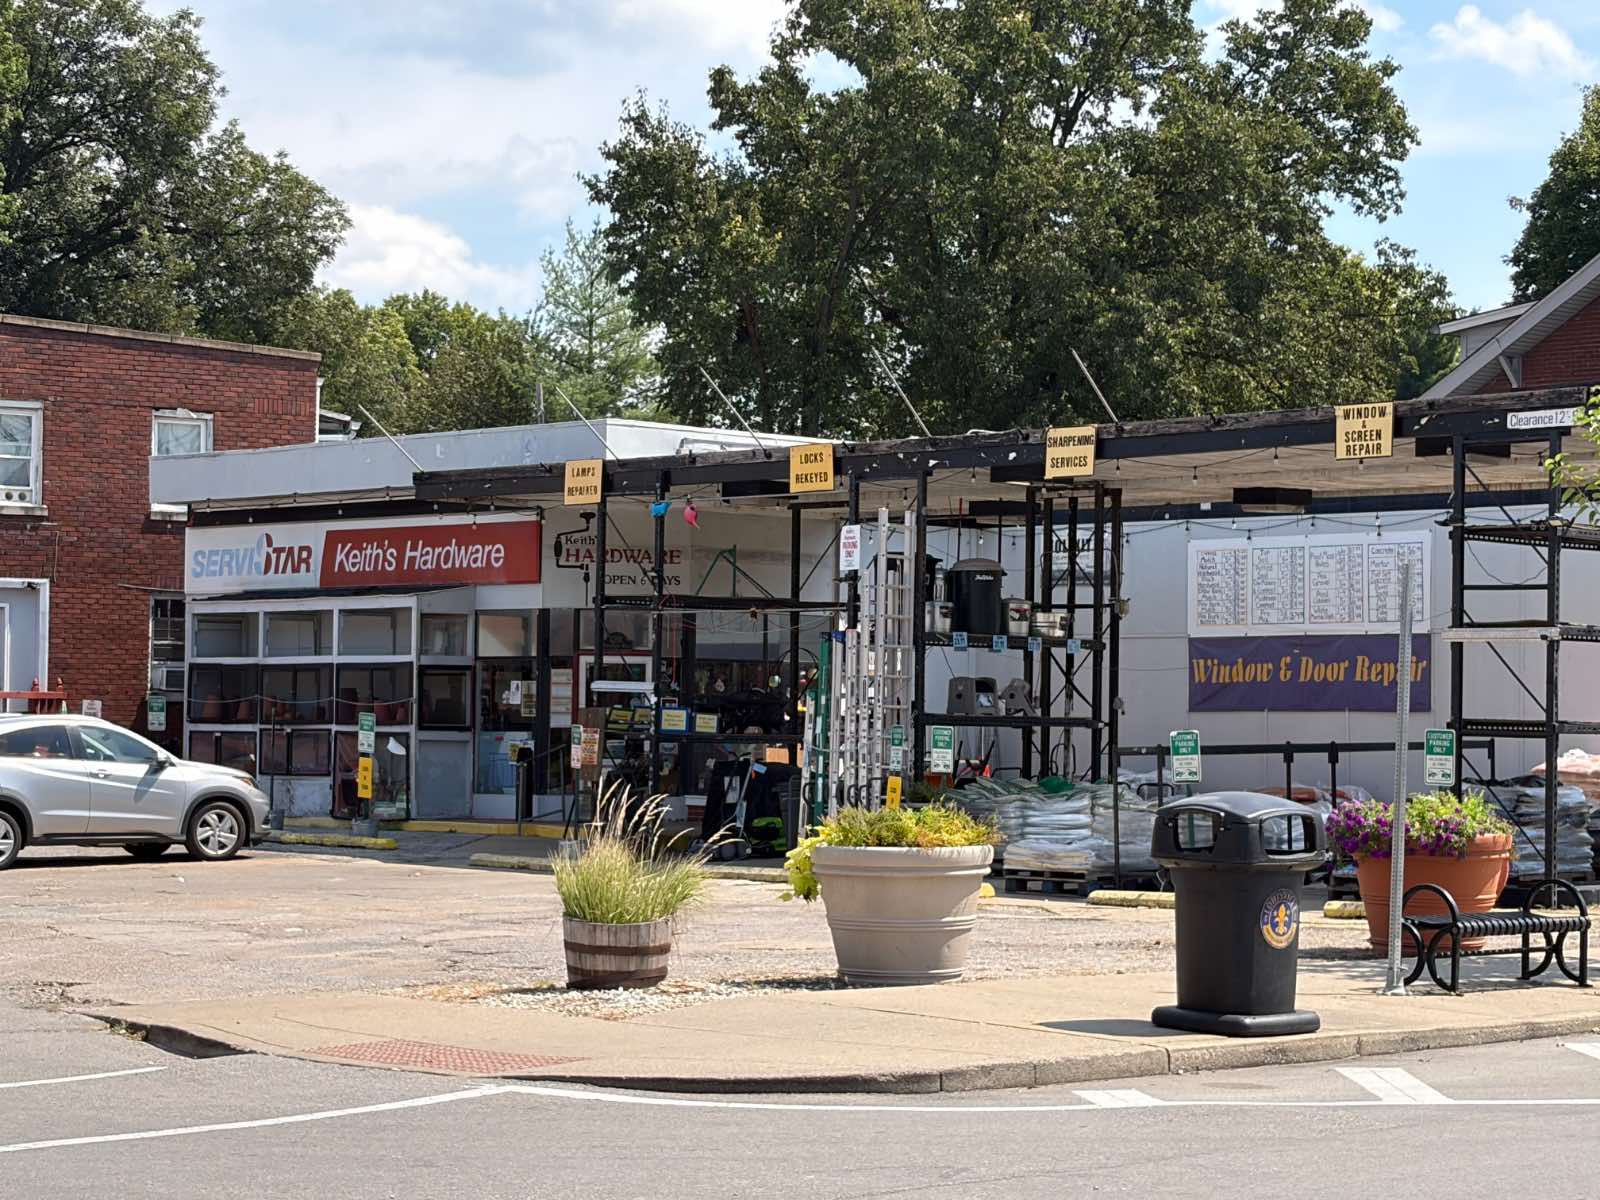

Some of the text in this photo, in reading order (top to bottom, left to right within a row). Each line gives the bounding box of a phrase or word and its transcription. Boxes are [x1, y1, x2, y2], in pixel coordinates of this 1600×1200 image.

[1343, 406, 1386, 420] WINDOW
[1361, 420, 1366, 429] &
[1510, 414, 1553, 427] Clearance
[1048, 435, 1094, 448] SHARPENING
[1344, 429, 1382, 443] SCREEN
[1345, 443, 1382, 456] REPAIR
[800, 452, 824, 464] LOCKS
[1050, 456, 1088, 468] SERVICES
[571, 467, 595, 478] LAMPS
[795, 472, 828, 484] REKEYED
[567, 485, 598, 496] REPAIRED
[191, 533, 312, 577] SERVISTAR
[334, 538, 505, 573] Keith's Hardware
[603, 575, 636, 585] OPEN
[640, 575, 647, 584] 6
[1192, 655, 1427, 686] Window & Door Repir
